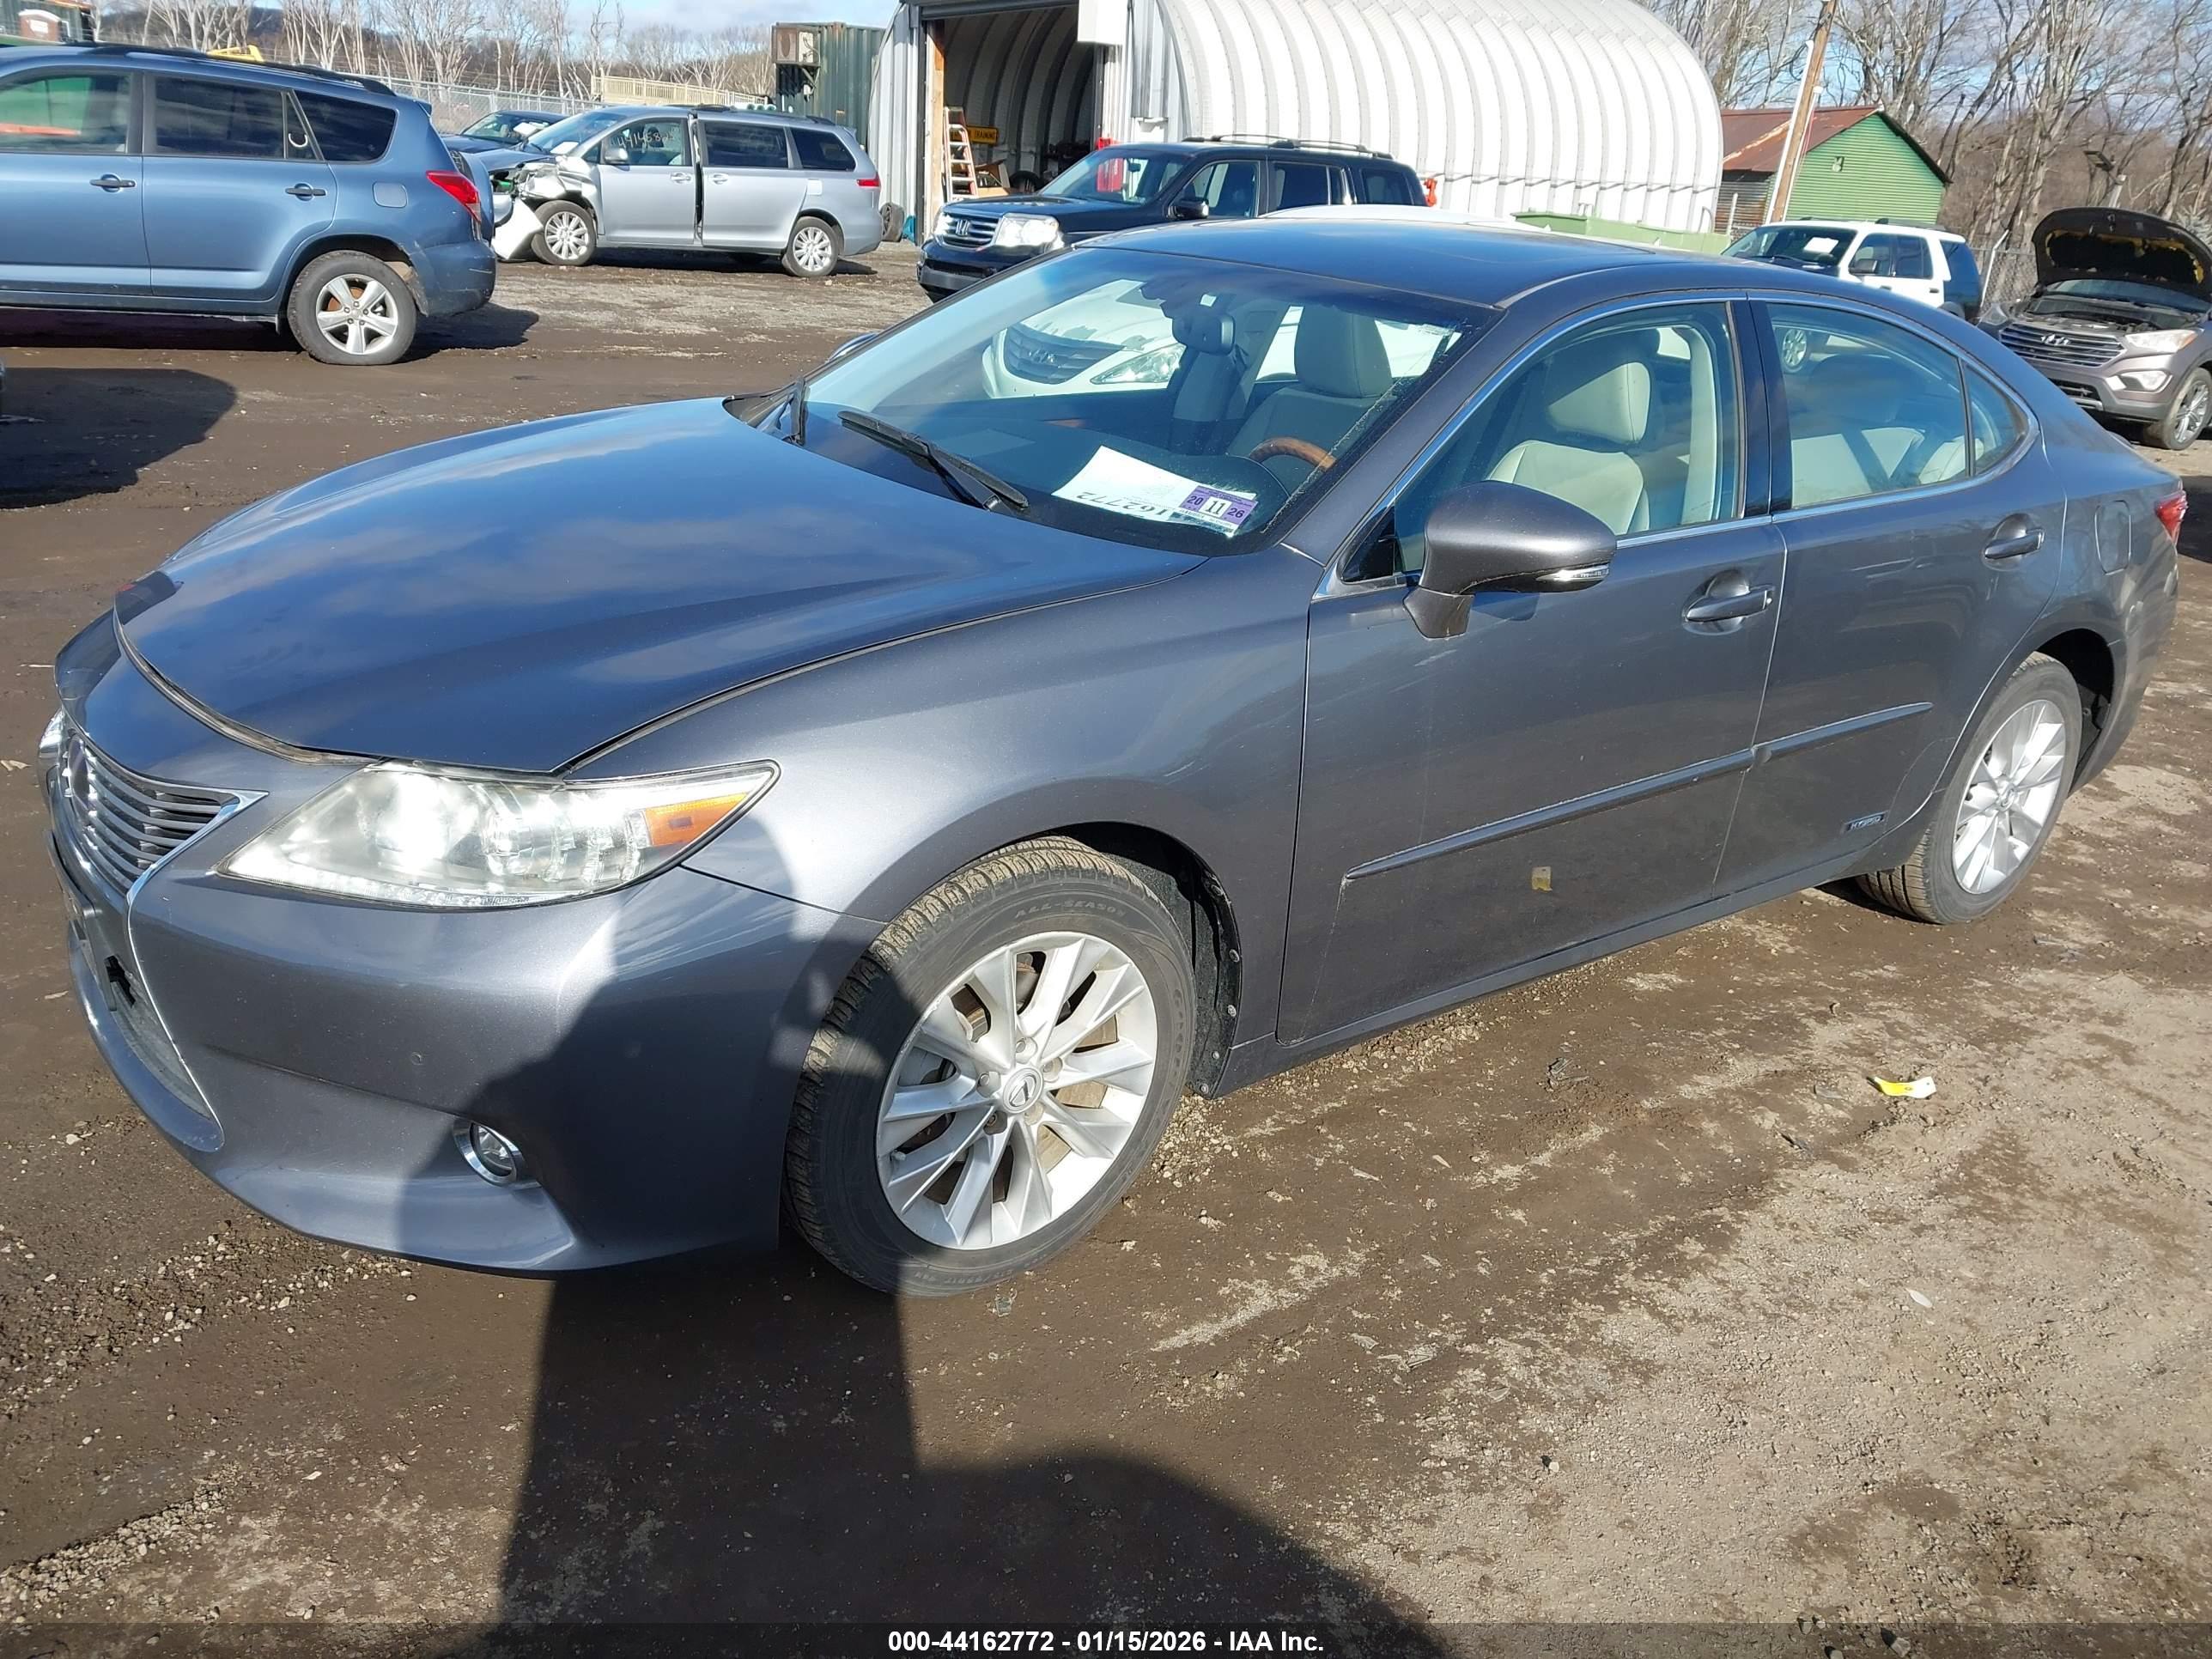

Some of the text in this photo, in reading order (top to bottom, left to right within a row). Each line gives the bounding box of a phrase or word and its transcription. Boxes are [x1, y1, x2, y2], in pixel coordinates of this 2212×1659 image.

[1076, 491, 1168, 515] 162772
[1187, 495, 1204, 506] 20
[1205, 500, 1226, 515] 11
[1227, 507, 1245, 519] 26
